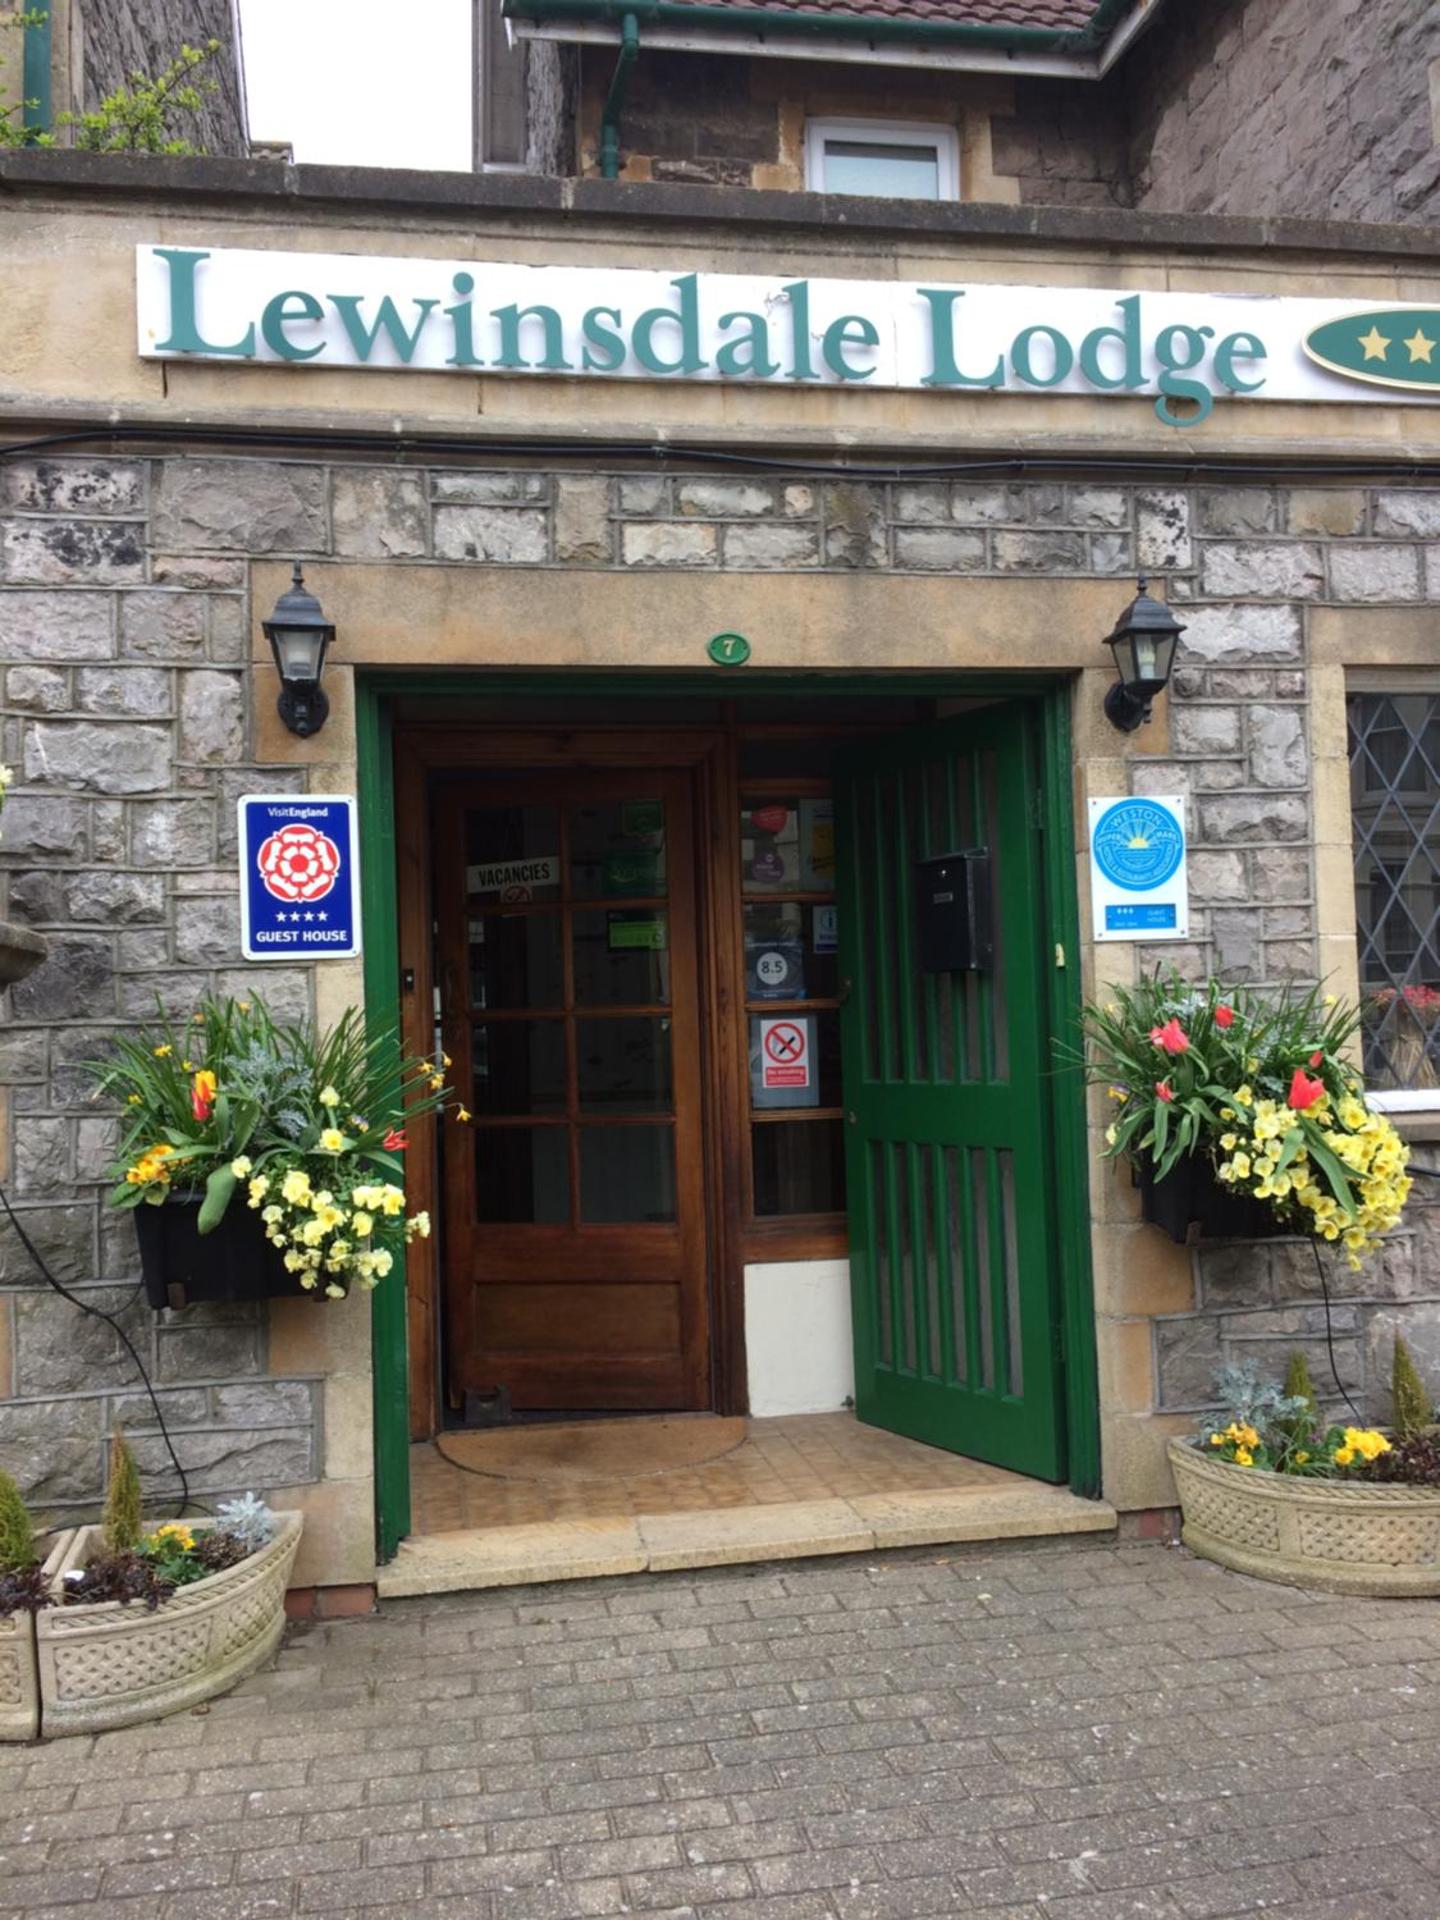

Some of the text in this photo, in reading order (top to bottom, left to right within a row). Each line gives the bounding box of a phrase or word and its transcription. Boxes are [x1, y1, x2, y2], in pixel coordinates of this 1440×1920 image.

[152, 247, 1267, 428] Lewinsdale Lodge
[723, 639, 737, 657] 7
[268, 807, 329, 819] VisitEngland
[1110, 807, 1163, 828] WESTON
[478, 862, 551, 887] VACANCIES
[256, 930, 348, 942] GUEST HOUSE
[761, 960, 783, 974] 8.5
